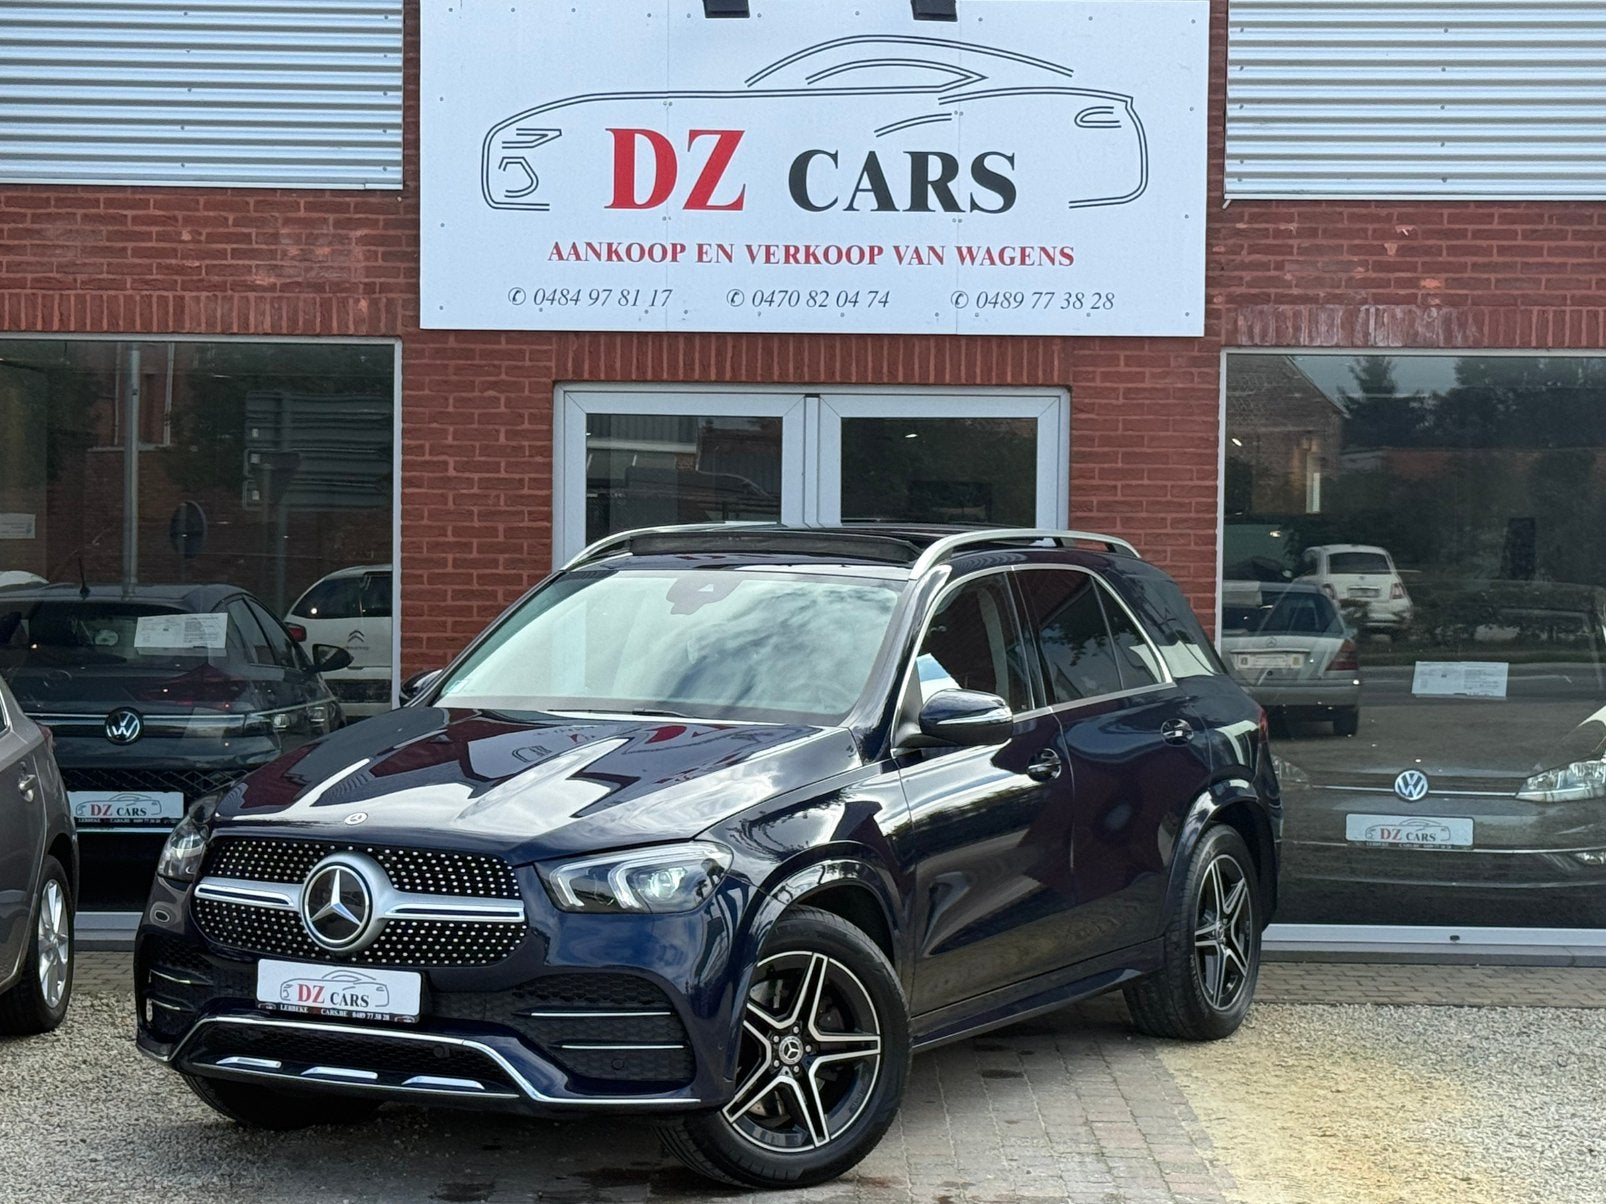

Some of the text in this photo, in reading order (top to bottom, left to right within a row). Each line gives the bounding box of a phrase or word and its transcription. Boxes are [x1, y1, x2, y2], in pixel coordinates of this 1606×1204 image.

[604, 128, 1017, 214] DZ CARS
[548, 241, 1075, 267] AANKOOP EN VERKOOP VAN WAGENS
[533, 288, 673, 307] 0484 97 81 17
[752, 289, 890, 309] 0470 82 04 74
[975, 291, 1115, 310] 0489 77 38 28
[90, 803, 147, 817] DZ CARS
[1380, 828, 1437, 842] DZ CARS
[297, 983, 370, 1008] DZ CARS
